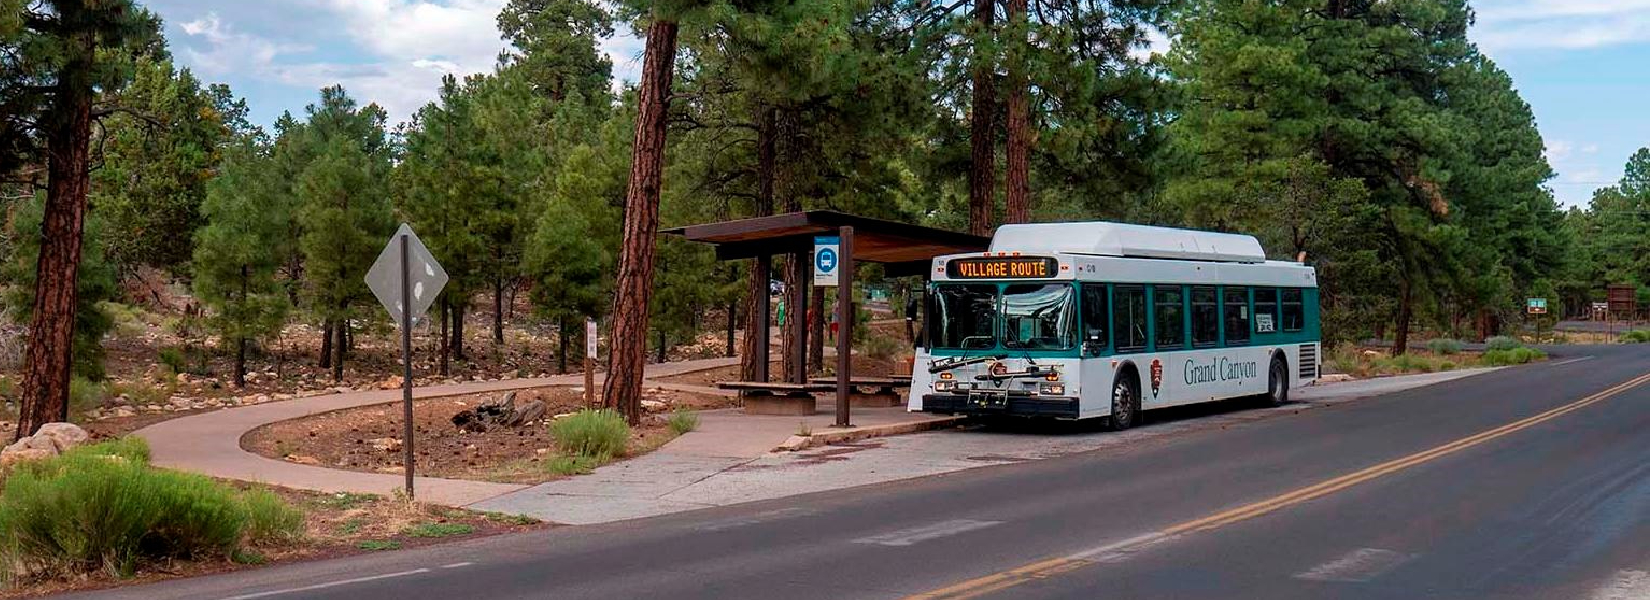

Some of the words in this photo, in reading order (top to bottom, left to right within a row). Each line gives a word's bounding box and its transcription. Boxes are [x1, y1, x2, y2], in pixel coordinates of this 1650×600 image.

[960, 262, 1007, 276] VILLAGE
[1011, 261, 1045, 276] ROUTE
[1184, 357, 1216, 385] Grand
[1220, 356, 1256, 382] Canyon
